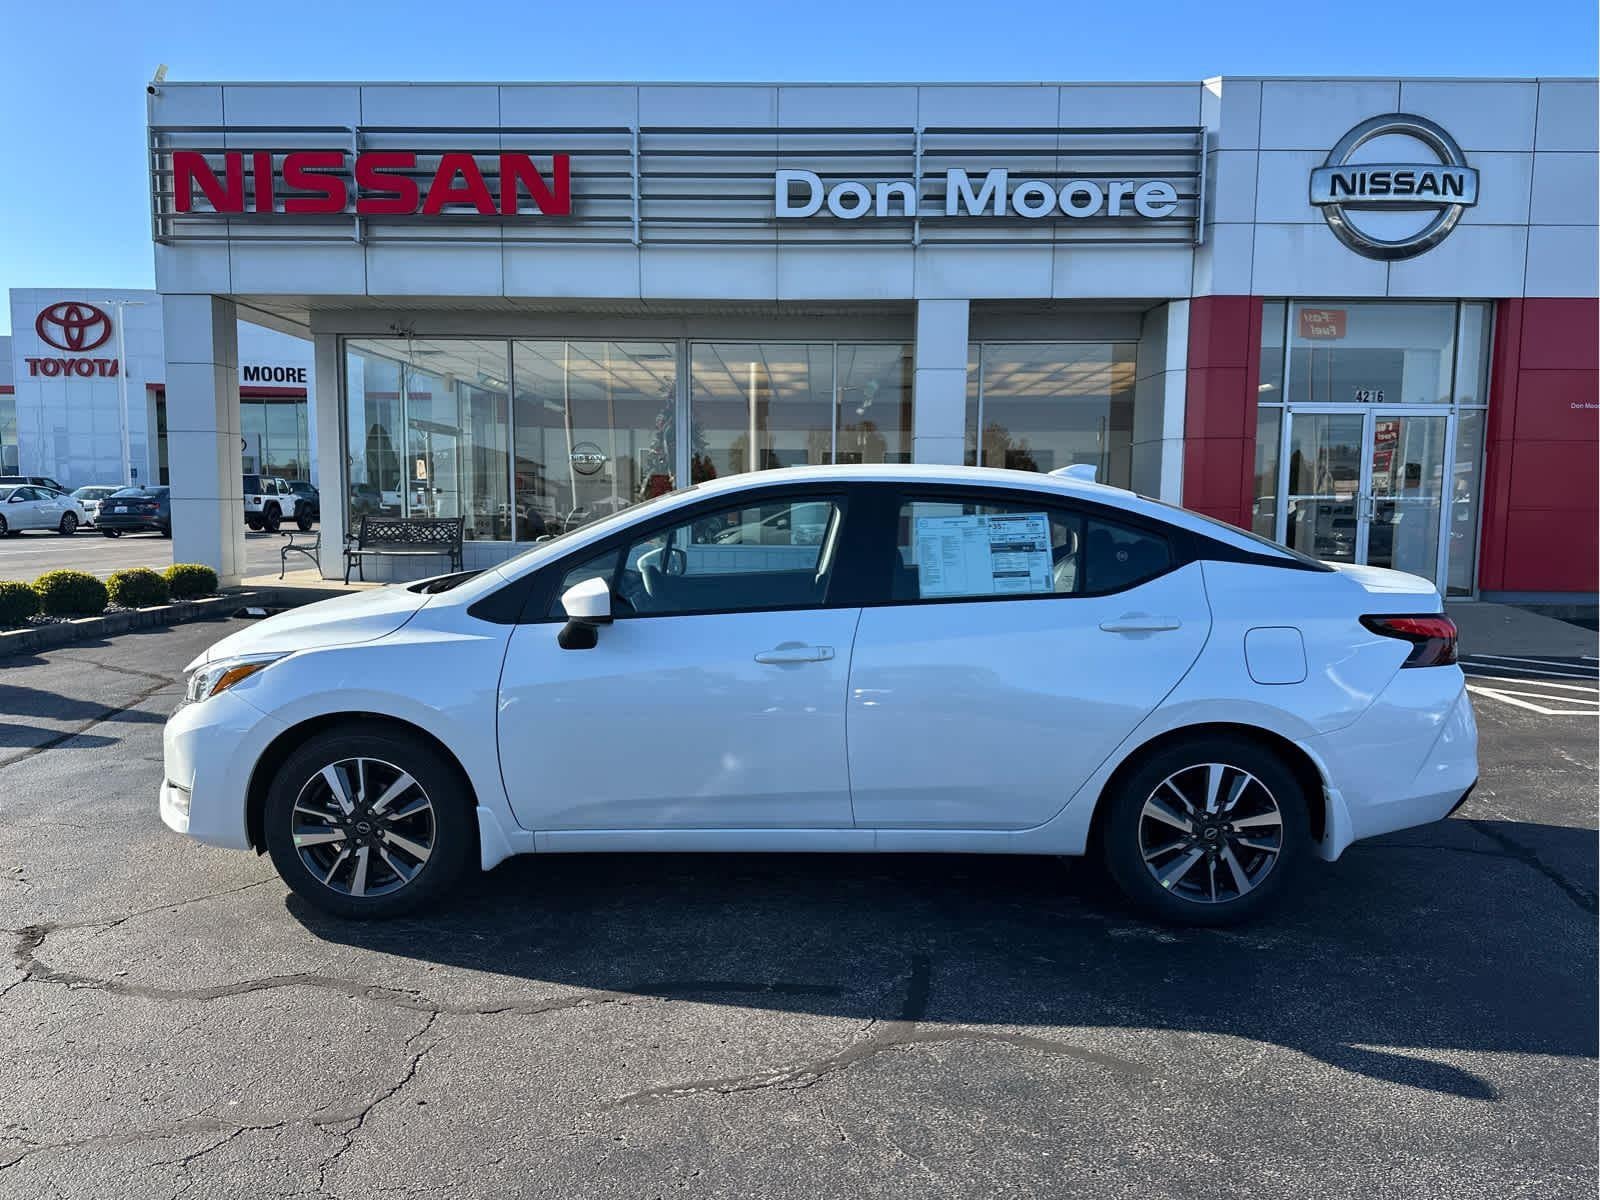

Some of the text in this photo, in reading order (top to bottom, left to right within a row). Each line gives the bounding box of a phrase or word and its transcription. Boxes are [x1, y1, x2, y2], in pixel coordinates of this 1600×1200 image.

[172, 151, 572, 216] NISSAN
[775, 168, 1178, 220] Don Moore
[1330, 171, 1465, 198] NISSAN
[25, 358, 129, 378] TOYOTA
[243, 365, 308, 384] MOORE
[1355, 390, 1385, 403] 4216
